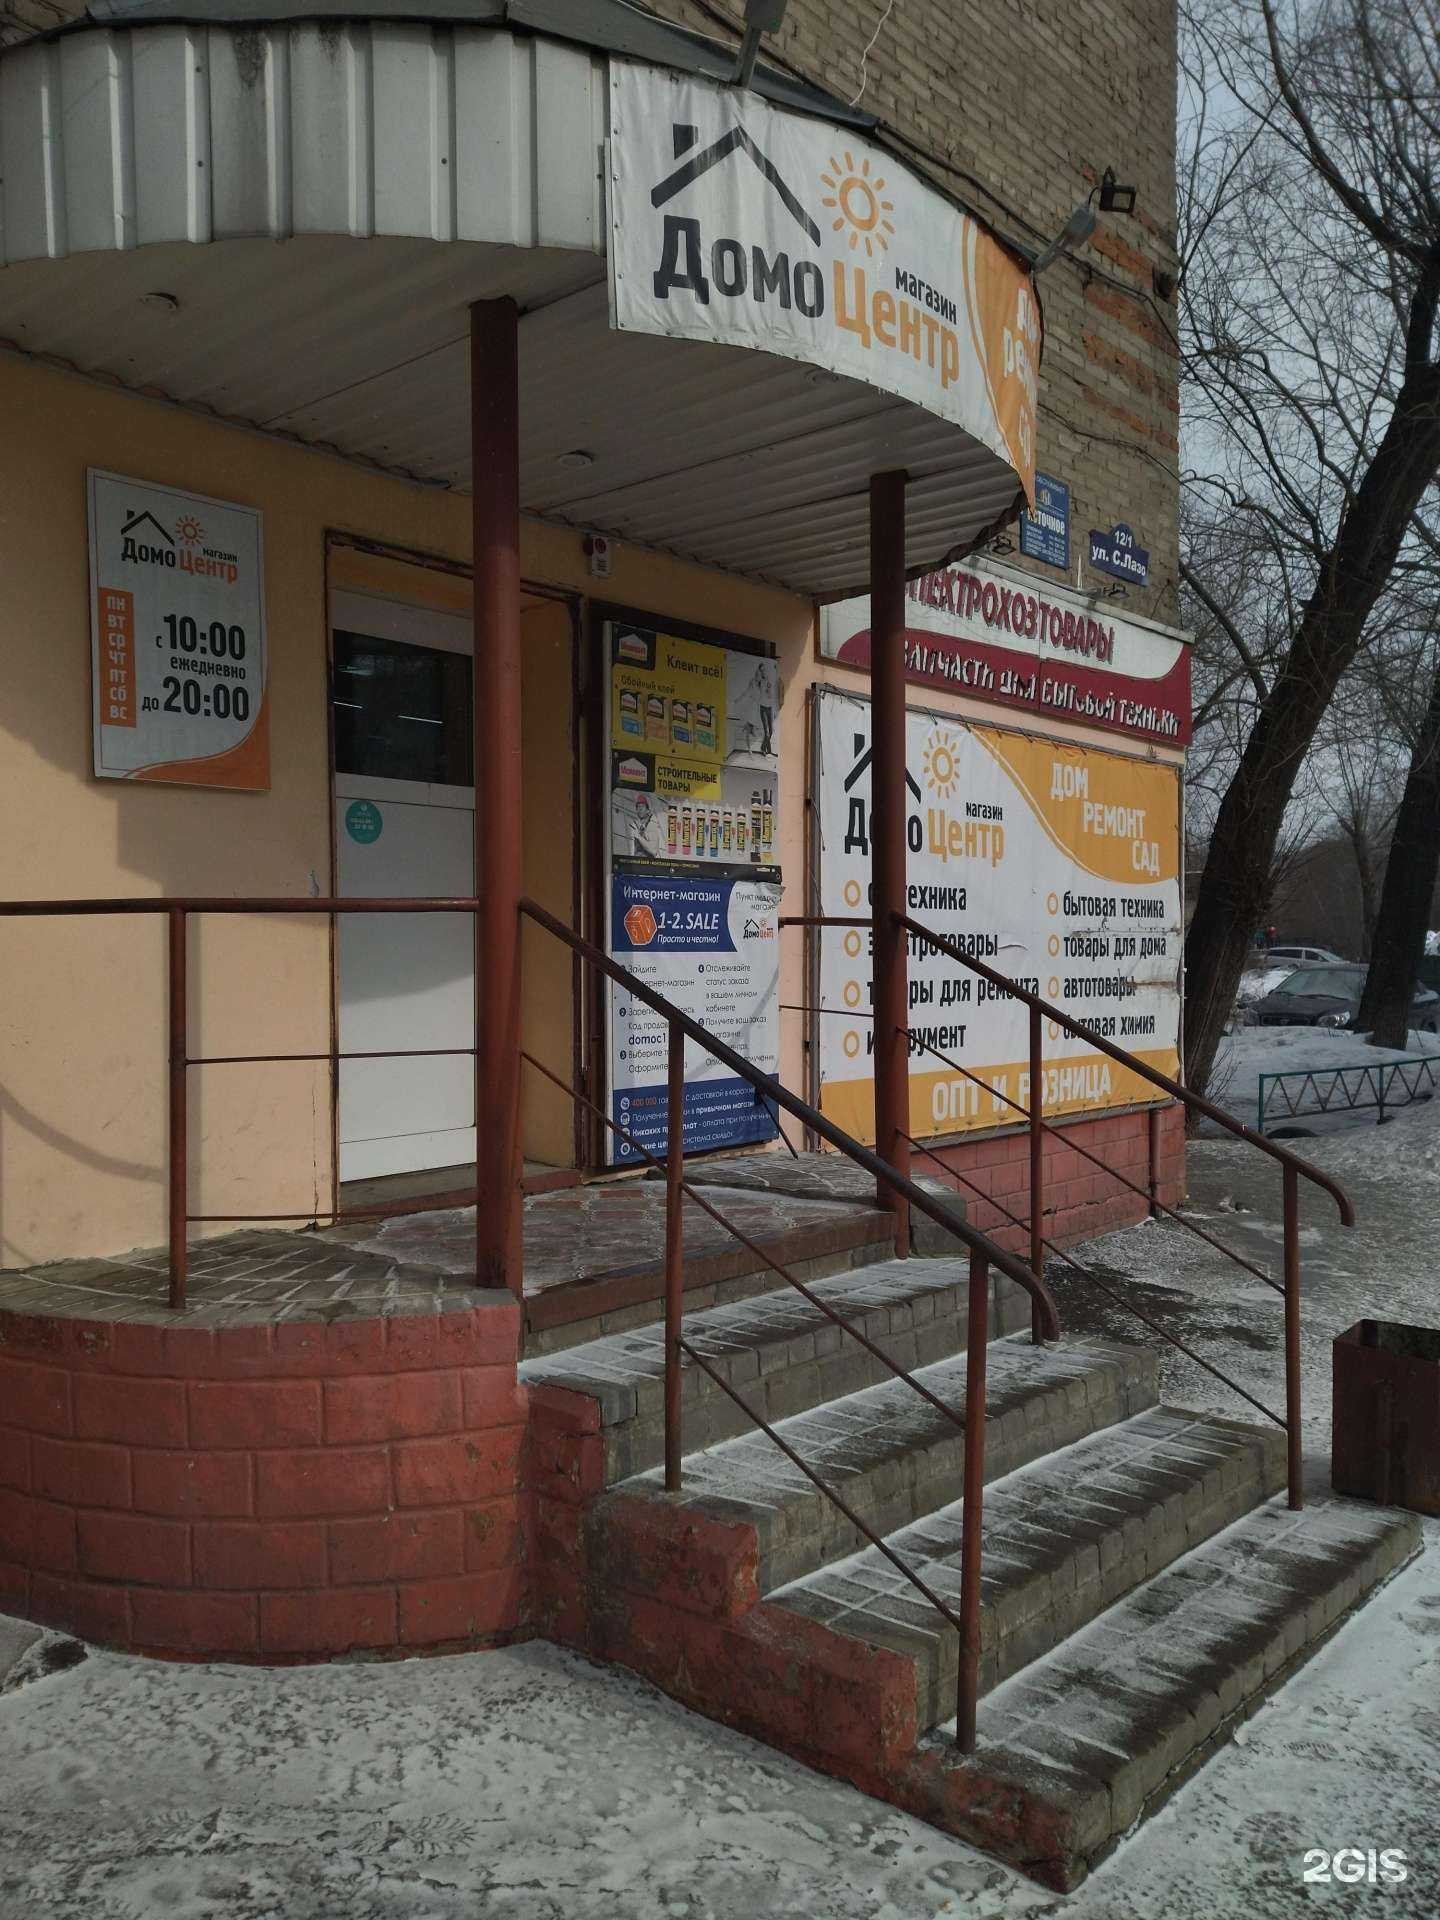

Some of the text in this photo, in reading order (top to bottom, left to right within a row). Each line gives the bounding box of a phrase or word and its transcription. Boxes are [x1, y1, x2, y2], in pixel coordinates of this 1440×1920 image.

[895, 267, 957, 325] магазин
[1114, 530, 1132, 549] 12/1
[203, 548, 238, 563] магазин
[1092, 545, 1109, 561] ул.
[905, 570, 1115, 665] ЛЕКТРОХОЗТОВАРЫ
[156, 614, 246, 661] с 10:00
[170, 656, 246, 680] ежедневно
[667, 655, 698, 673] Клеит
[142, 676, 249, 722] до 20:00
[657, 766, 717, 784] СТРОИТЕЛЬНЫЕ
[657, 779, 691, 792] ТОВАРЫ
[1051, 762, 1089, 802] ДОМ
[965, 802, 1003, 821] магазин
[1083, 800, 1146, 839] РЕМОНТ
[1132, 840, 1160, 877] САД
[624, 886, 721, 902] Интернет-магазин
[1063, 890, 1165, 918] бытовая техника
[657, 934, 686, 945] Просто
[692, 934, 719, 943] честно!
[1064, 936, 1167, 962] товары для дома
[940, 978, 971, 1007] для
[1064, 975, 1136, 1001] автотовары
[1120, 1015, 1156, 1036] химия
[628, 1032, 666, 1046] domoc1
[932, 1079, 981, 1121] ОПТ
